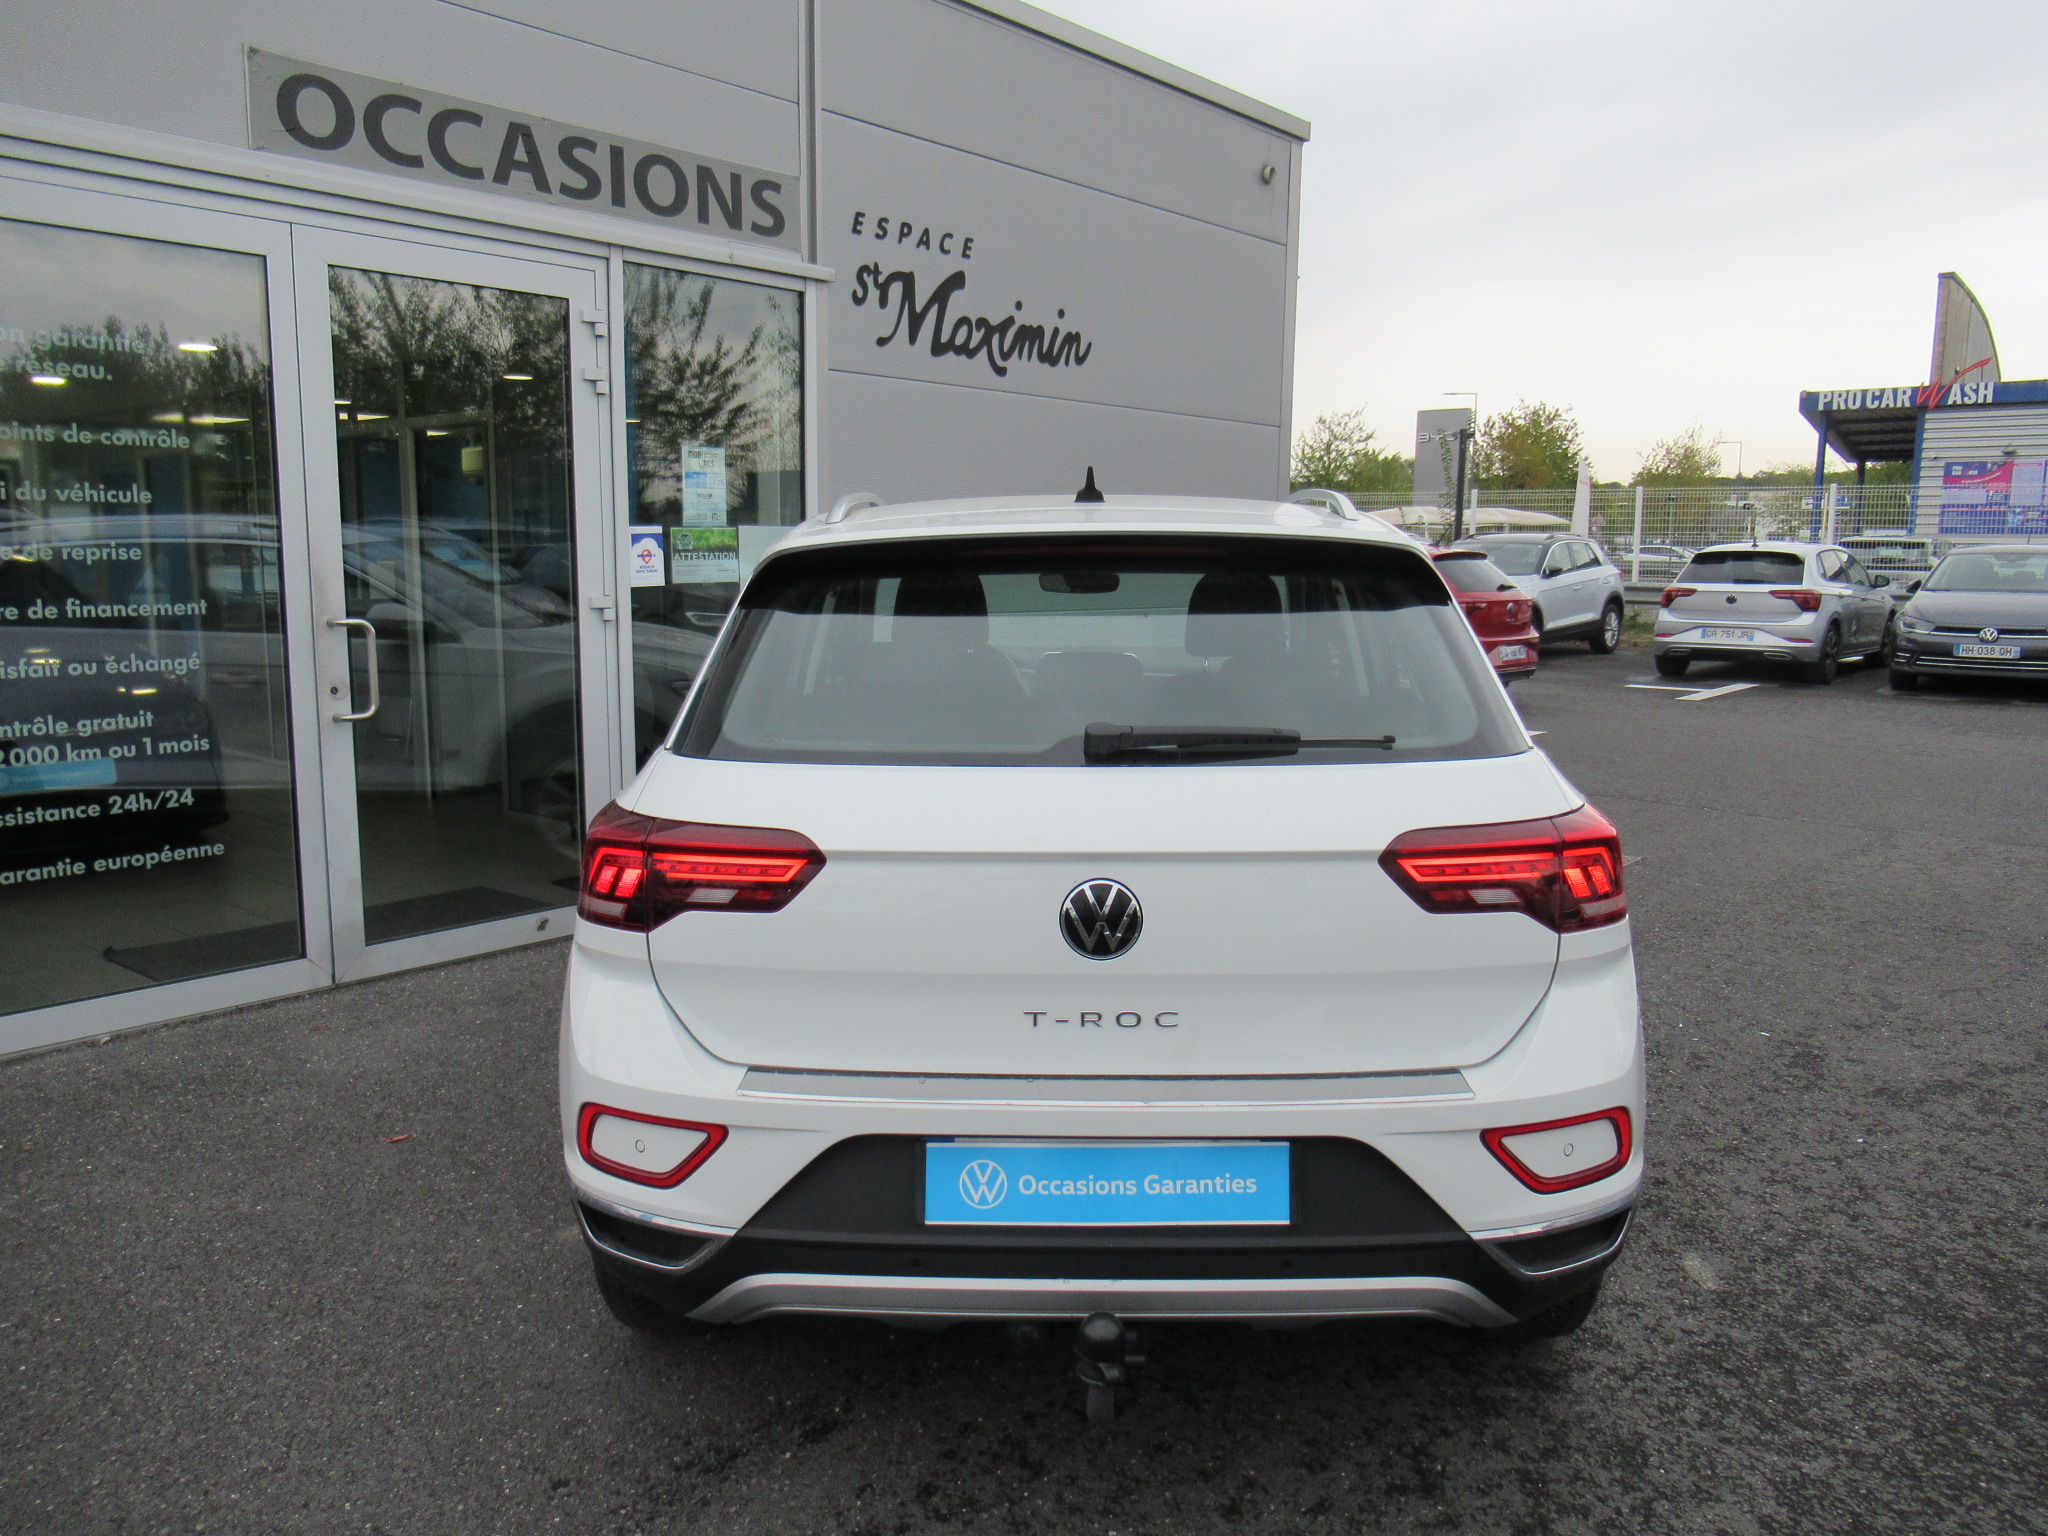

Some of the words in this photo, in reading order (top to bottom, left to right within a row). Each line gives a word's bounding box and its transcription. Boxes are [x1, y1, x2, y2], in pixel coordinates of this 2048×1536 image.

[276, 73, 786, 238] OCCASIONS
[852, 211, 974, 260] ESPACE
[876, 270, 1092, 377] Maximin
[16, 353, 113, 381] réseau.
[1818, 390, 1862, 411] PRO
[1866, 387, 1912, 408] CAR
[1915, 366, 1994, 409] WASH
[63, 422, 93, 444] de
[101, 429, 191, 449] contrôle
[16, 480, 47, 501] du
[55, 482, 153, 504] véhicule
[23, 543, 53, 560] de
[62, 542, 142, 565] reprise
[674, 552, 736, 561] ATTESTATION
[28, 599, 58, 619] de
[66, 598, 207, 618] financement
[68, 662, 97, 676] ou
[105, 652, 200, 675] échangé
[77, 710, 154, 737] gratuit
[66, 743, 102, 762] km
[108, 742, 136, 760] ou
[142, 737, 152, 755] 1
[159, 734, 210, 754] mois
[108, 788, 194, 815] 24h/24
[94, 843, 225, 869] européenne
[1023, 1010, 1180, 1028] T-ROC
[1018, 1173, 1137, 1195] Occasions
[1143, 1173, 1257, 1195] Garanties
